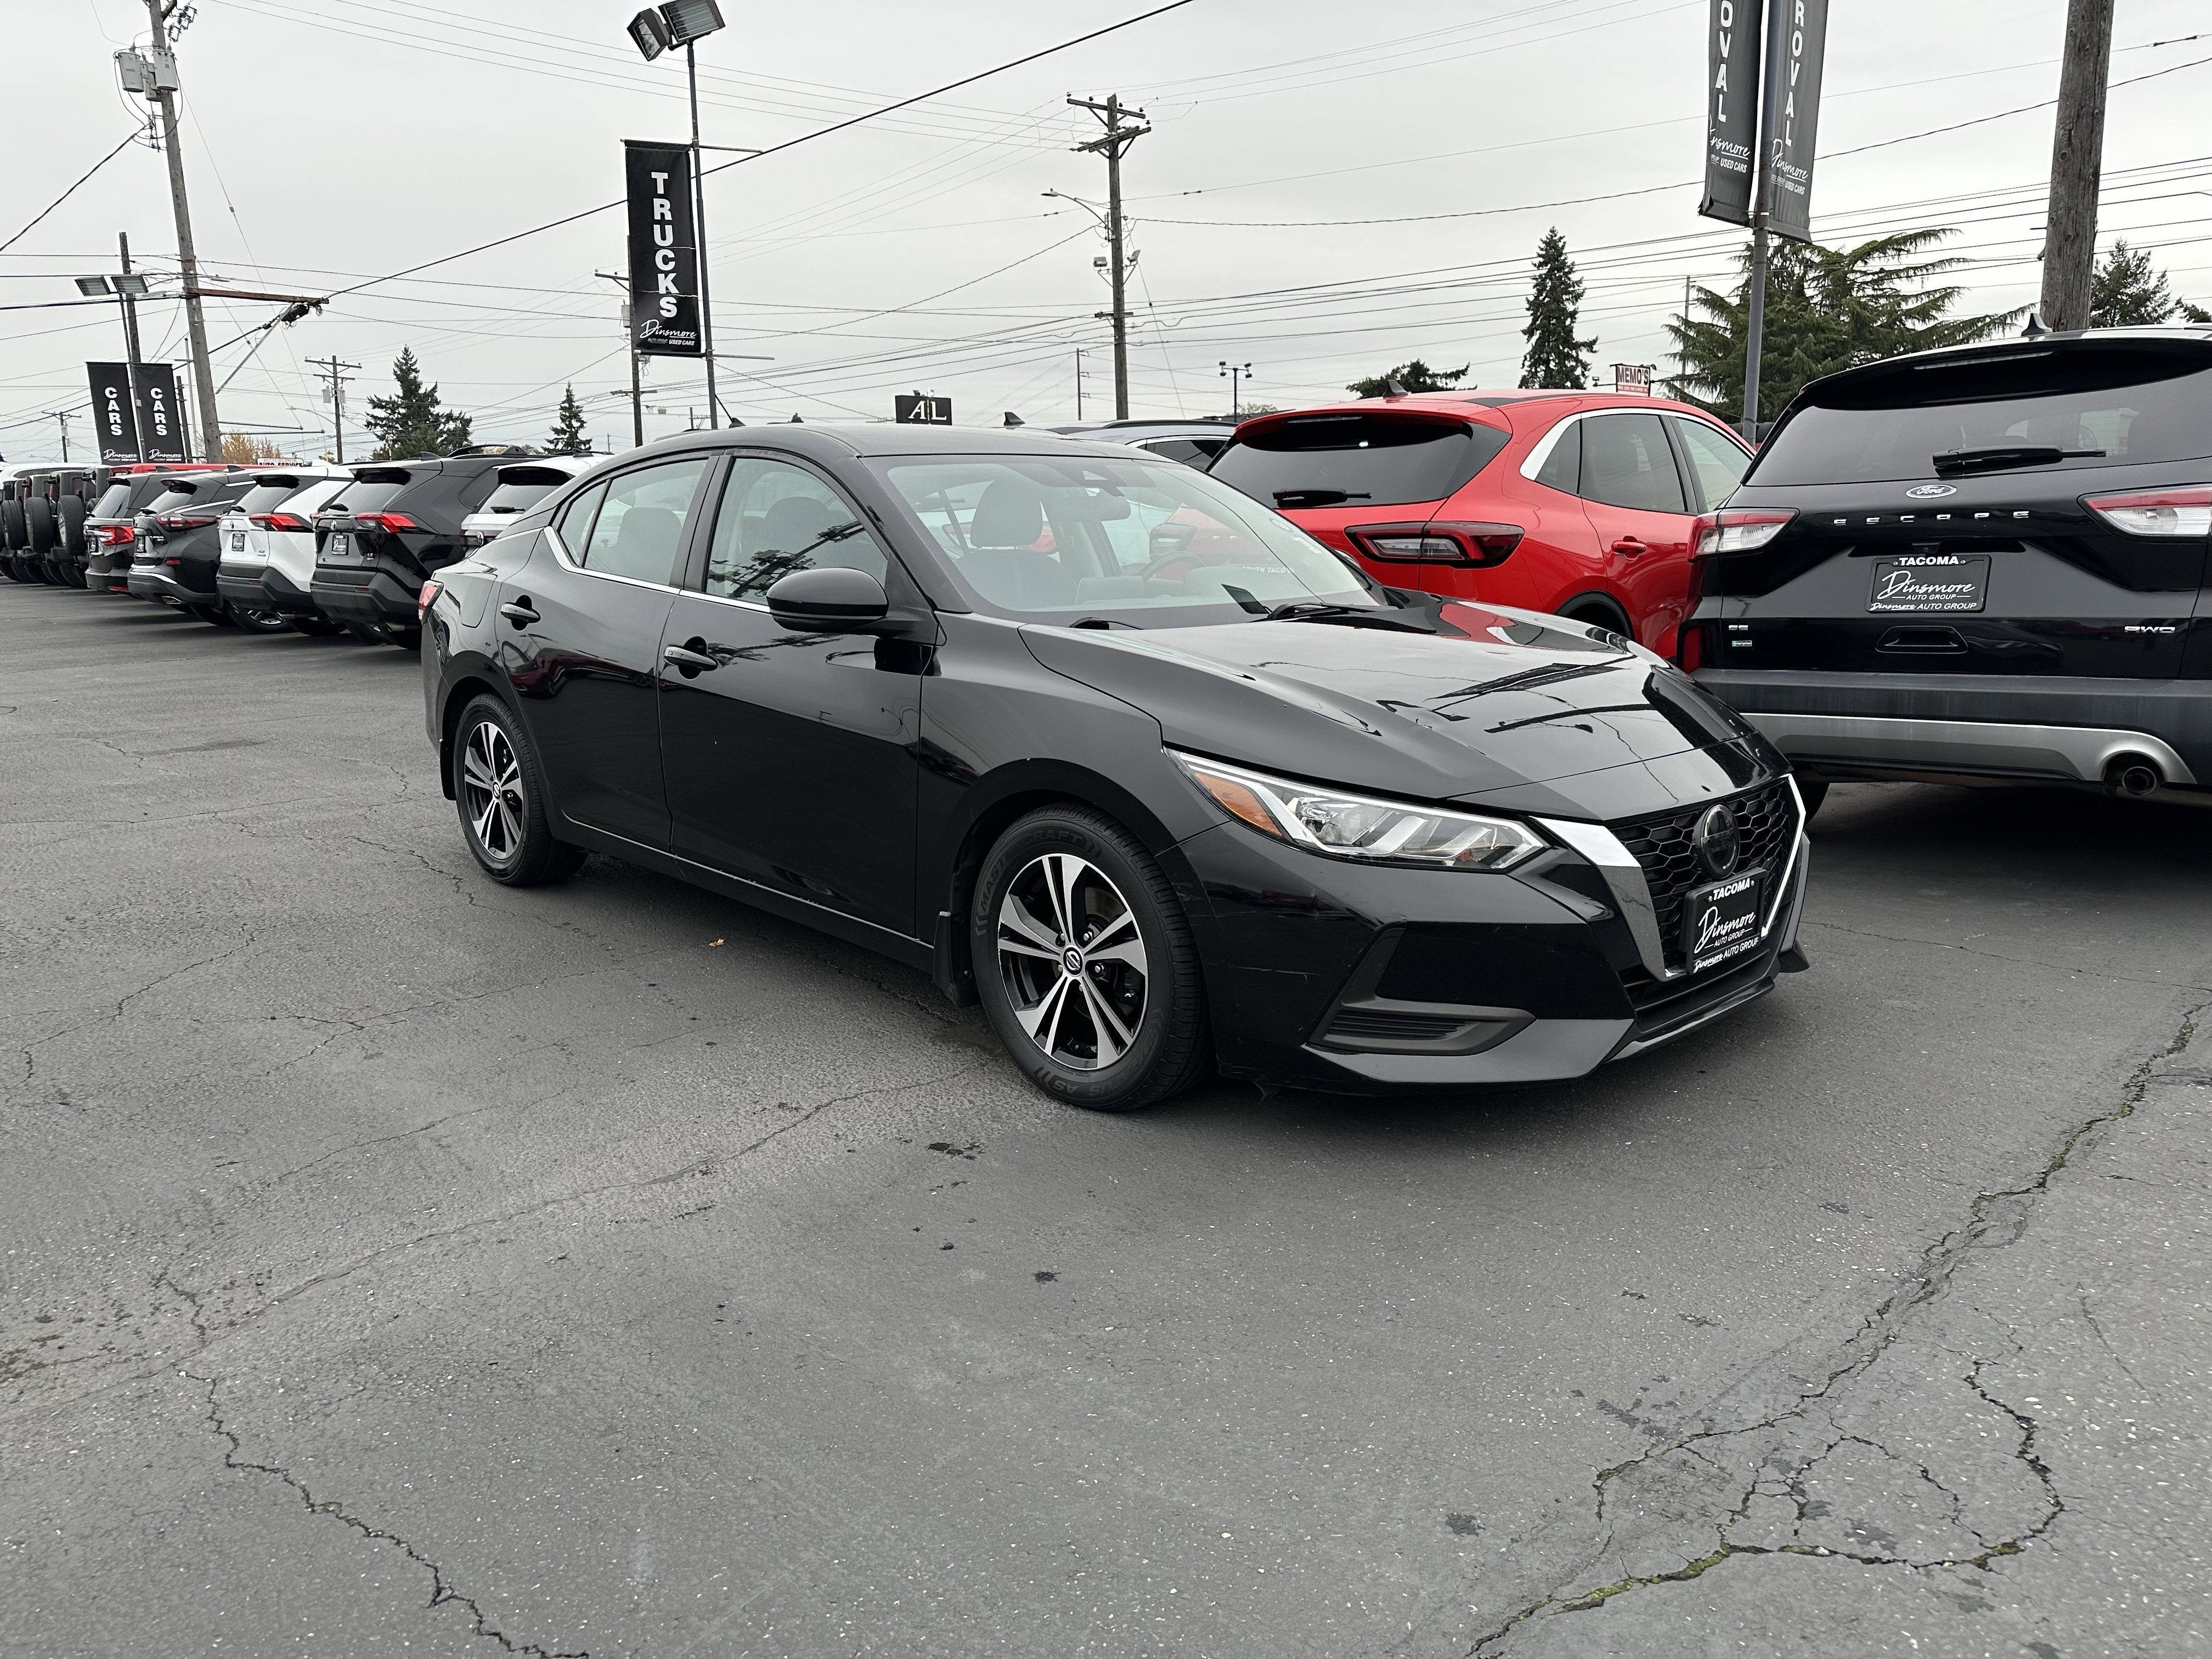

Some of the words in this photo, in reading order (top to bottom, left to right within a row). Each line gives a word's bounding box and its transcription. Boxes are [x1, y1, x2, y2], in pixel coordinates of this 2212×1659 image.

[1716, 0, 1733, 123] OVAL
[1785, 0, 1804, 146] ROVAL
[1720, 157, 1734, 170] USED
[1734, 162, 1747, 173] CARS
[1771, 138, 1808, 182] Dinsmore
[1785, 180, 1795, 191] USED
[1794, 184, 1805, 195] CARS
[651, 172, 679, 318] TRUCKS
[640, 319, 697, 338] Dinsmore
[1617, 367, 1648, 385] MEMO'S
[105, 387, 122, 436] CARS
[150, 387, 167, 436] CARS
[1916, 486, 1945, 494] Ford
[1834, 511, 2029, 526] ESCAPE
[1899, 556, 1959, 566] TACOMA
[1877, 570, 1976, 600] Dinsmore
[1870, 602, 1916, 611] Dinsmore
[1708, 831, 1735, 849] NISSA
[980, 829, 1084, 913] MASTECRAFT
[1713, 877, 1750, 901] TACOMA
[1694, 906, 1756, 954] Dinsmore
[1714, 936, 1728, 948] AUTO
[1728, 929, 1745, 941] GROUP
[1693, 953, 1723, 974] Dinsmore
[1723, 947, 1740, 960] AUTO
[1740, 937, 1759, 952] GROUP
